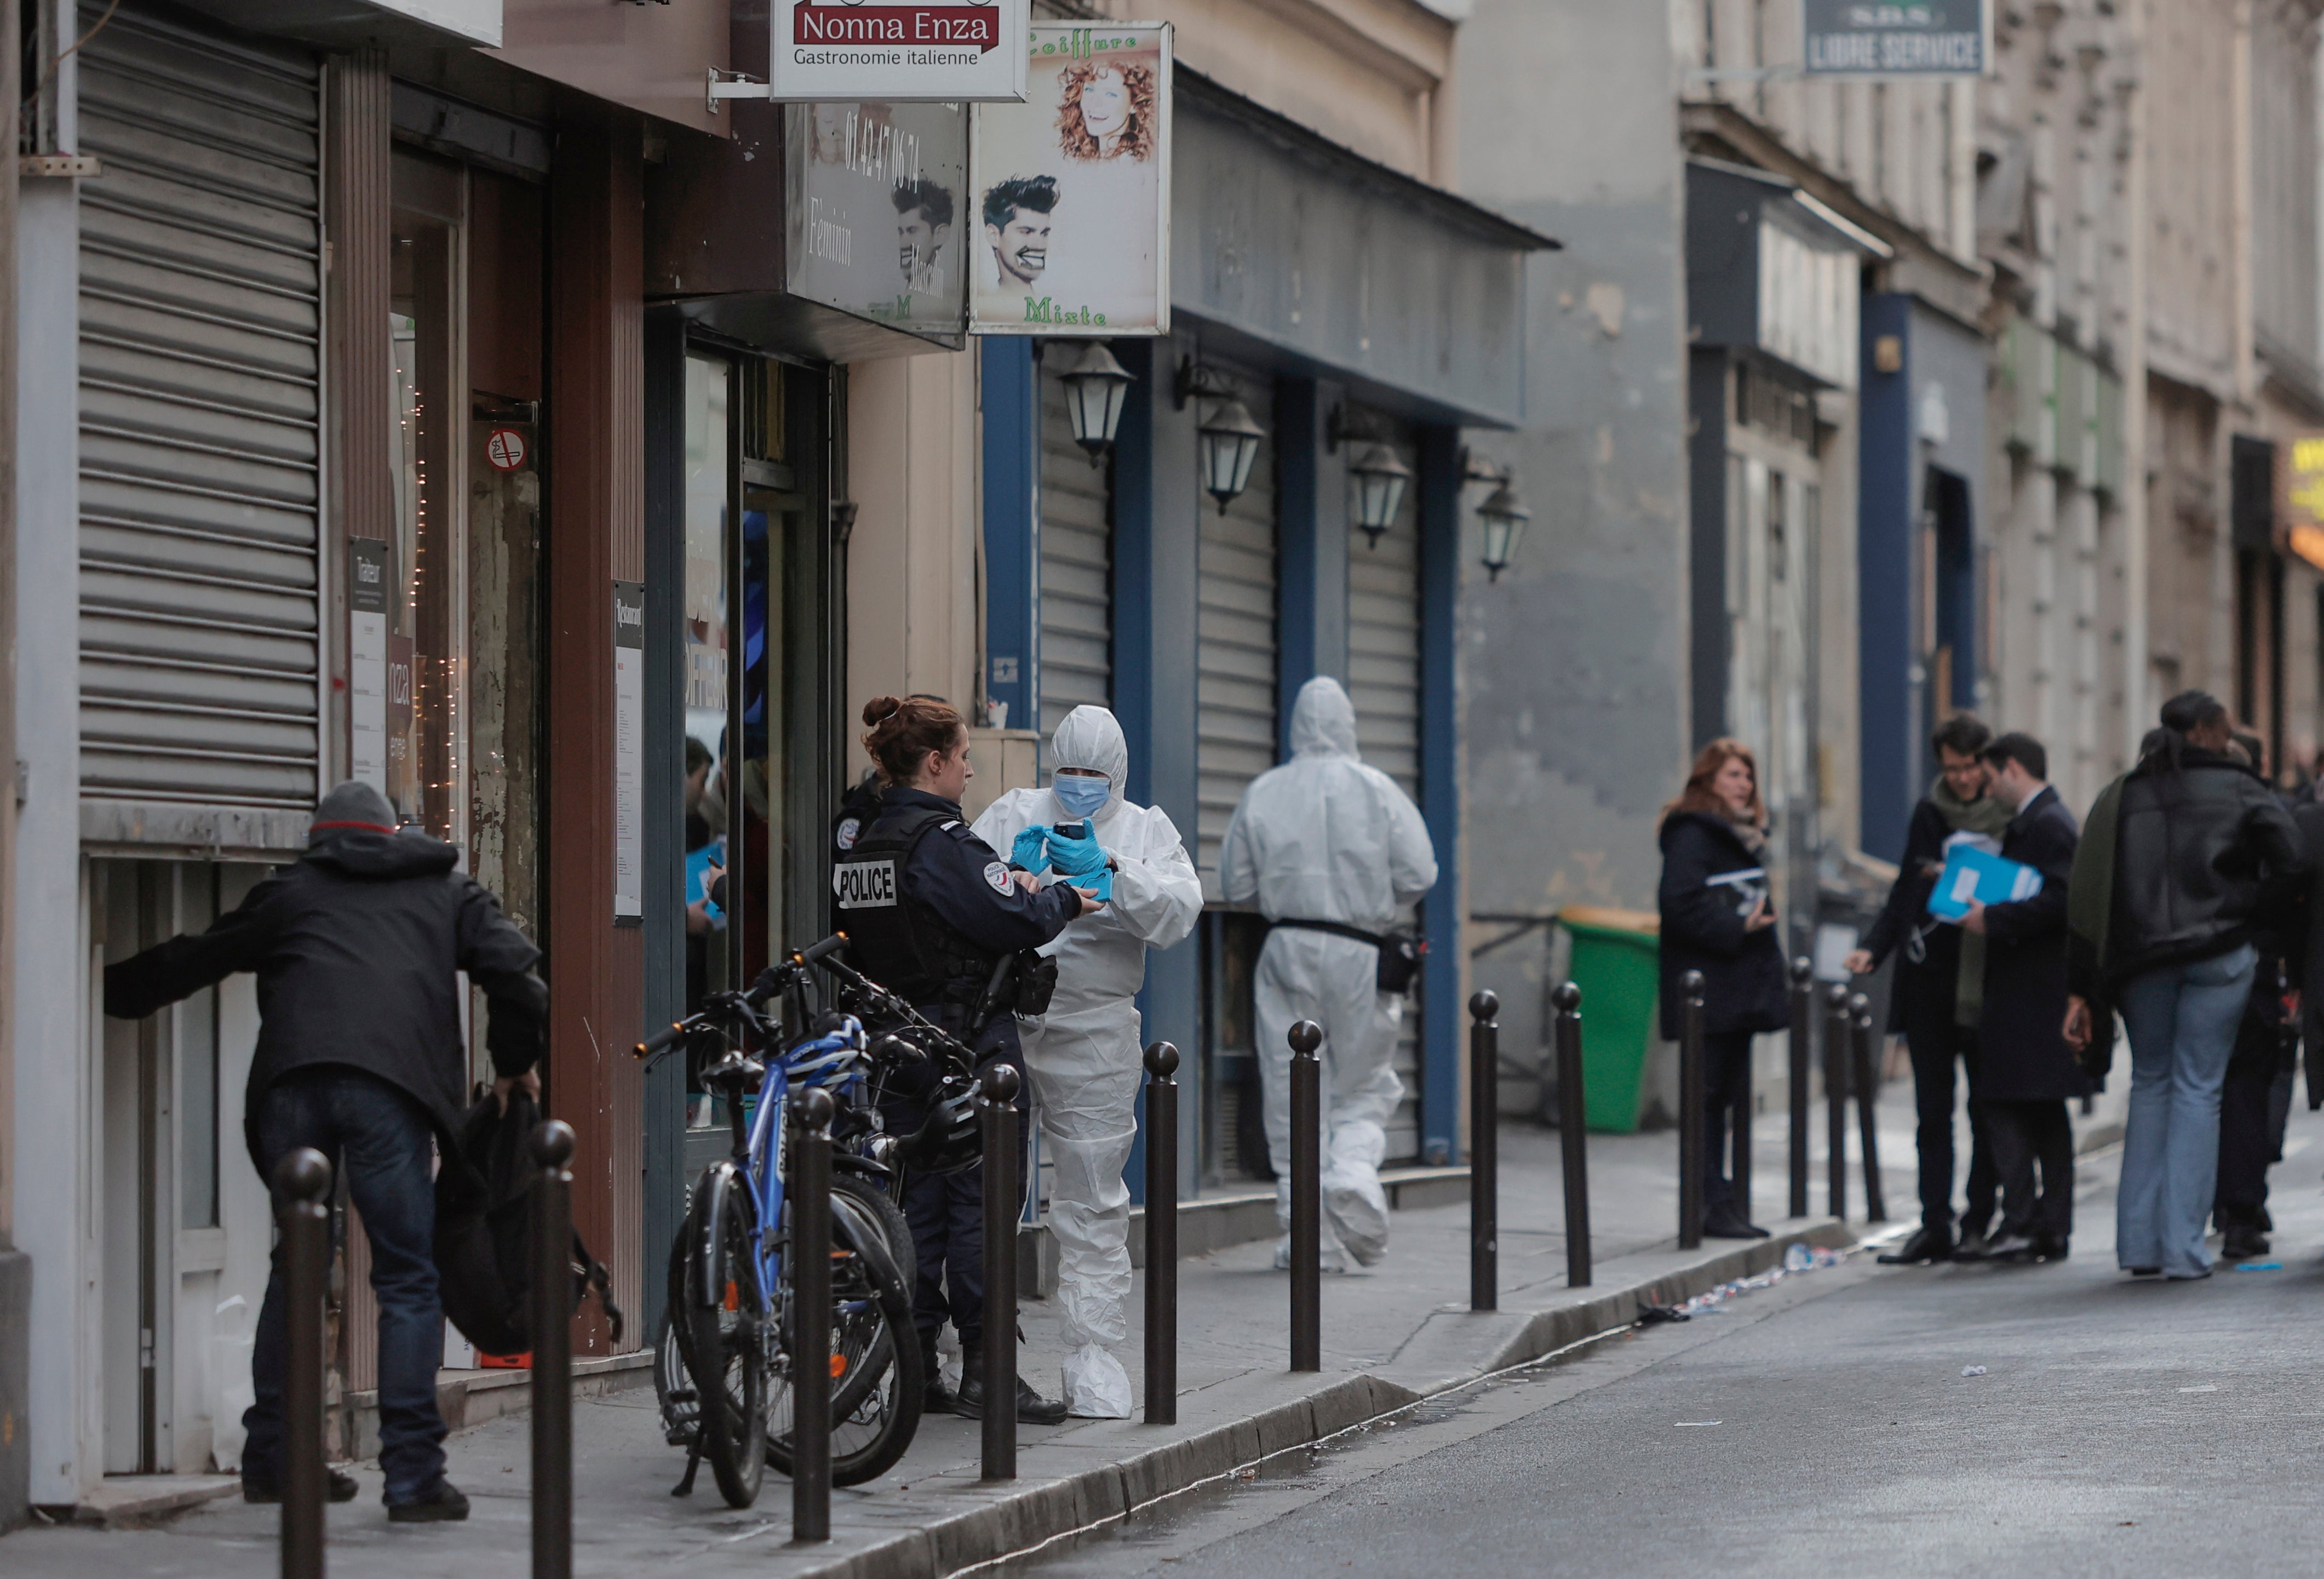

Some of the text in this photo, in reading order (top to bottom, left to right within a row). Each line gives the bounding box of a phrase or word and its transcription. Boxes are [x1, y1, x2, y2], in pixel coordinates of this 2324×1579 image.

[804, 12, 989, 40] Nonna Enza
[794, 49, 978, 65] Gastronomie italienne
[845, 111, 920, 194] 01 42 47 06 74
[909, 243, 944, 299] Masculin
[1024, 296, 1106, 326] Mixte
[840, 867, 893, 902] POLICE
